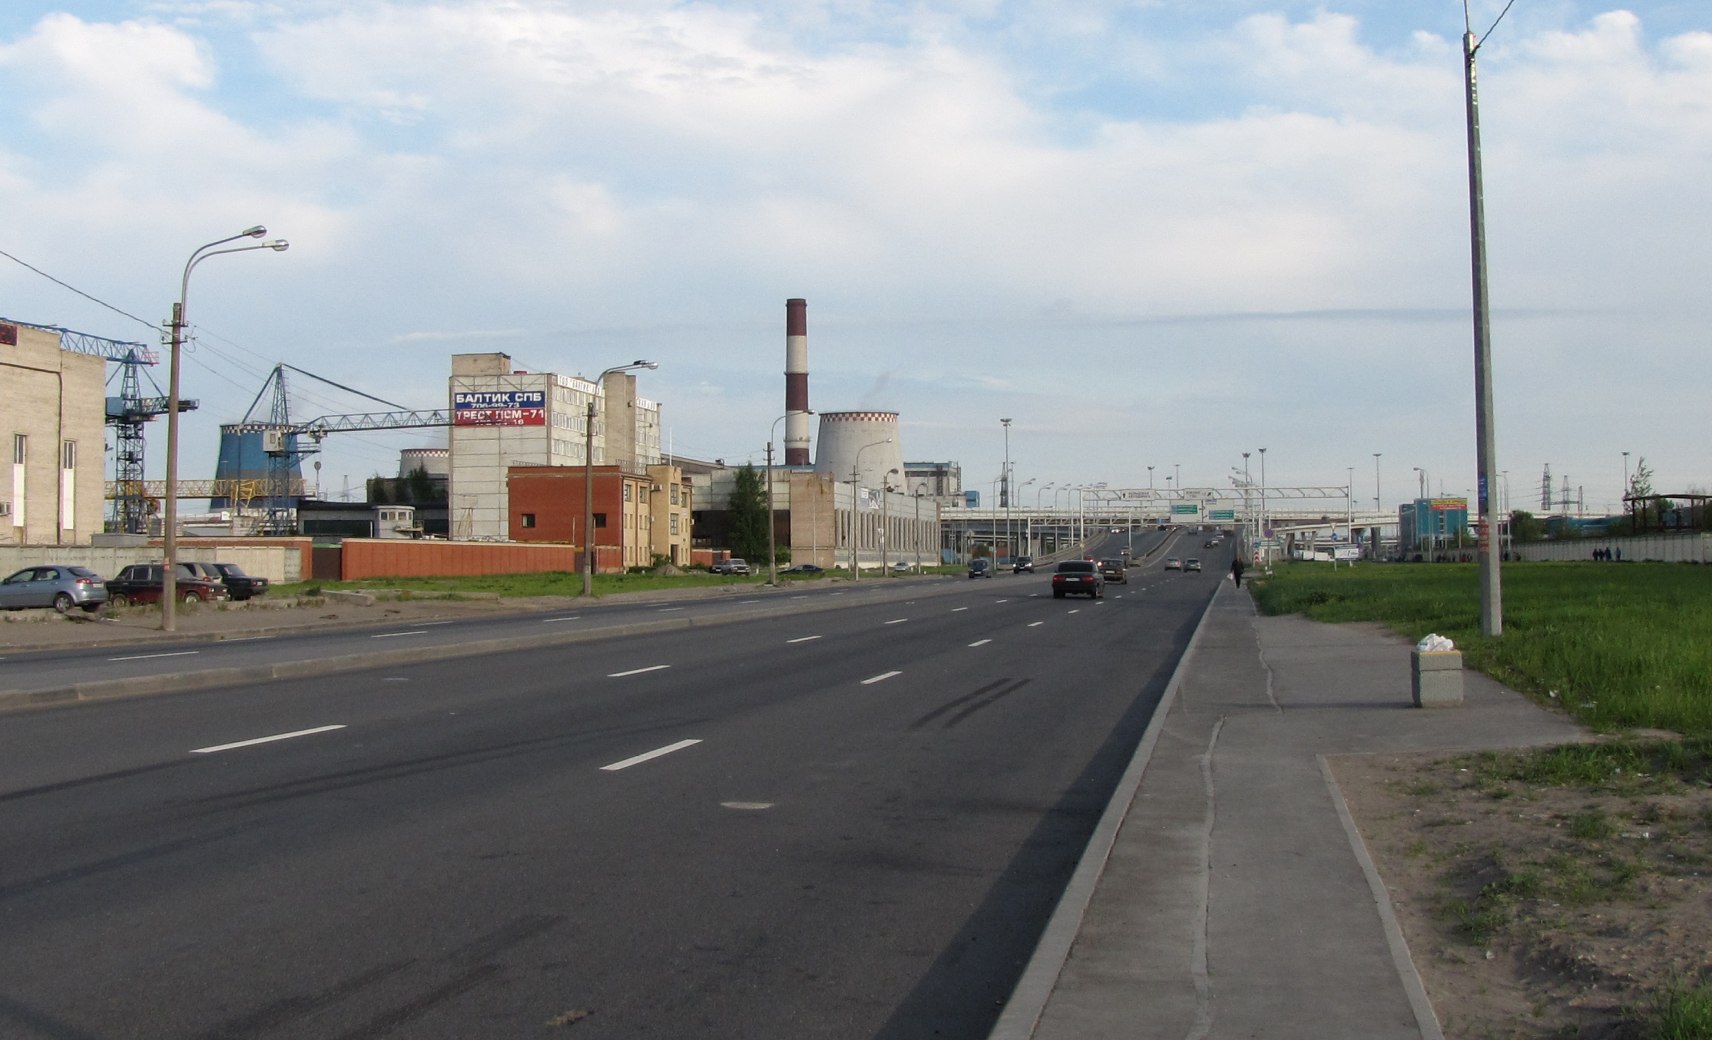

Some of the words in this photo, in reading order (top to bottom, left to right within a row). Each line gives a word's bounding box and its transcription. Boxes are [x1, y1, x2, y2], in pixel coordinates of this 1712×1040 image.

[456, 394, 510, 403] БАЛТИК
[515, 392, 541, 401] СПБ
[456, 411, 492, 420] ТРЕСТ
[495, 410, 544, 419] ПСМ-71
